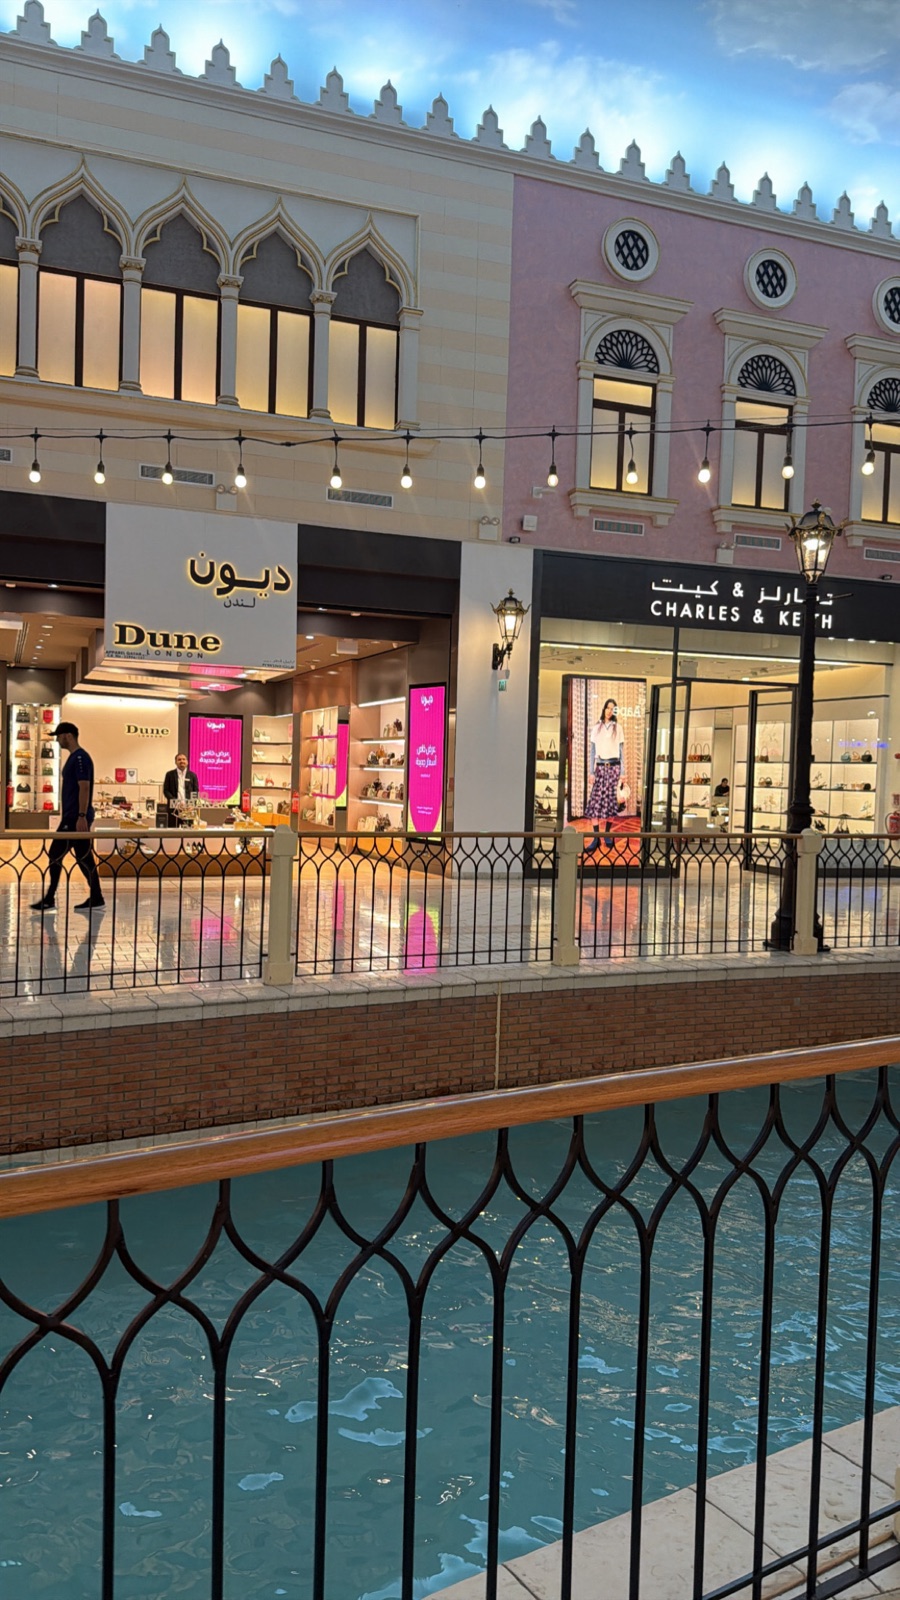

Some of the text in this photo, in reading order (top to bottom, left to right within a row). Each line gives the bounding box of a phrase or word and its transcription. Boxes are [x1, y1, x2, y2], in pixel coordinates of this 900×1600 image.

[189, 552, 291, 598] ديون
[223, 596, 256, 609] لندن
[651, 578, 834, 607] تارلز & كيت
[650, 600, 833, 630] CHARLES & KEH
[113, 623, 221, 652] Dune
[146, 649, 204, 659] LONDON
[126, 724, 169, 735] Dune
